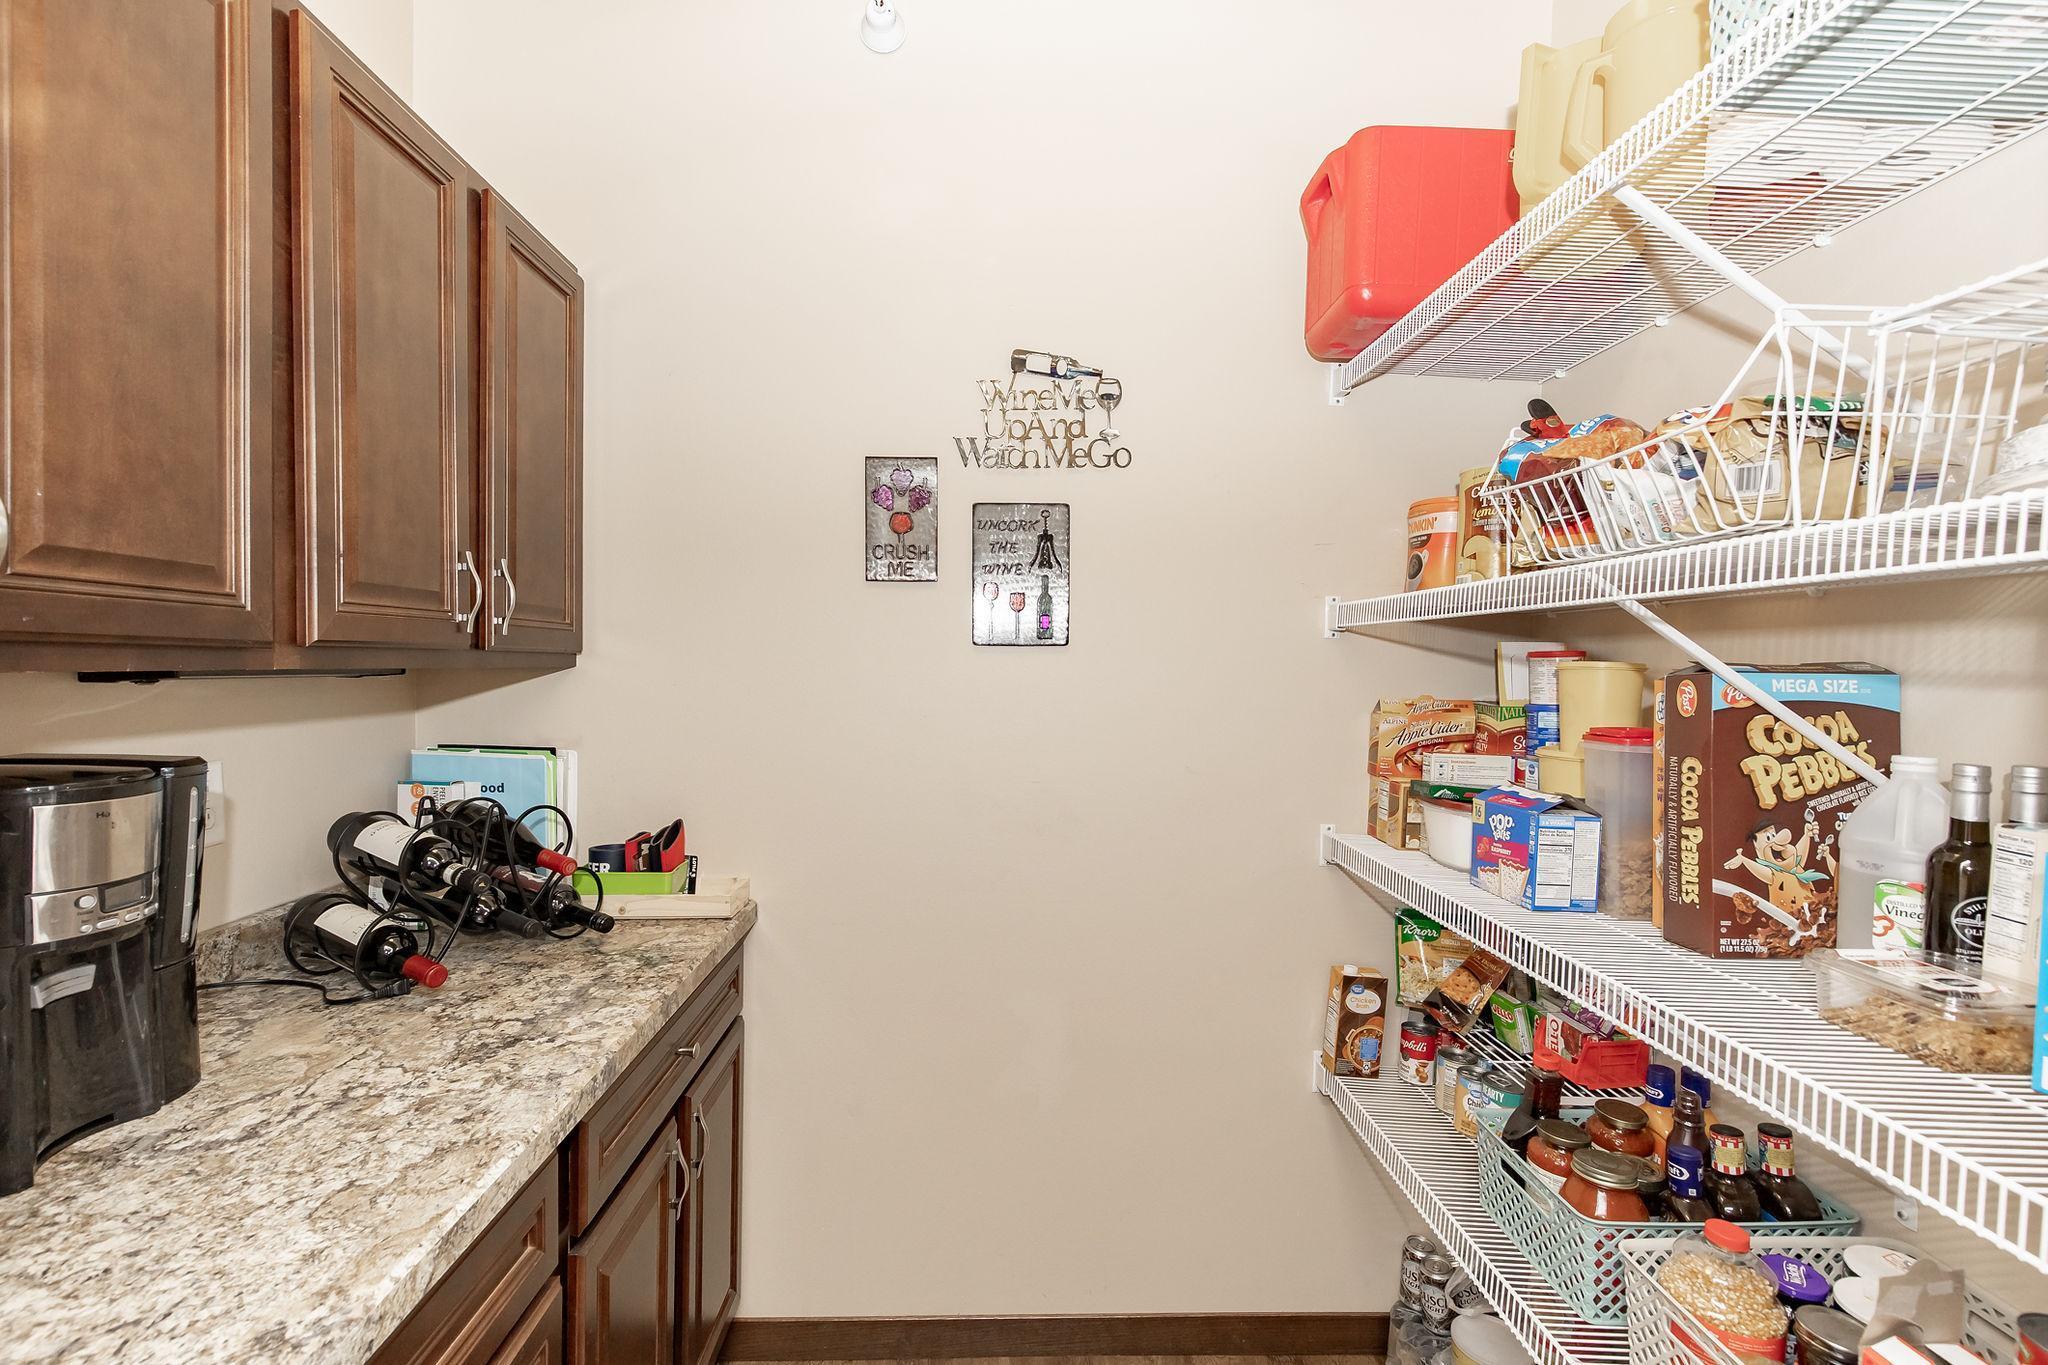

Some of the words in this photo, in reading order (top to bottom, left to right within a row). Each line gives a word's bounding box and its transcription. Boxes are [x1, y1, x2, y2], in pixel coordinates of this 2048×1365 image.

[977, 519, 1040, 532] UNCORK
[872, 544, 930, 562] CRUSH
[989, 540, 1018, 555] THE
[888, 561, 914, 578] ME
[982, 562, 1023, 576] WINE
[1771, 679, 1819, 695] MEGA
[1823, 680, 1859, 695] SIZE
[1681, 686, 1695, 713] Post
[1384, 724, 1430, 749] Apple
[1429, 719, 1463, 736] Cider
[1417, 738, 1446, 747] ORIGINAL
[1668, 756, 1679, 802] NATURALLY
[480, 782, 505, 794] ood
[1681, 756, 1703, 822] COCOA
[1474, 803, 1483, 818] 16
[1668, 809, 1678, 859] ARTIFICIALLY
[1681, 825, 1705, 907] PEBBLES
[1667, 860, 1678, 902] FLAVORED
[1402, 923, 1440, 939] Knorr
[1719, 938, 1731, 946] NET
[1730, 938, 1740, 946] WT
